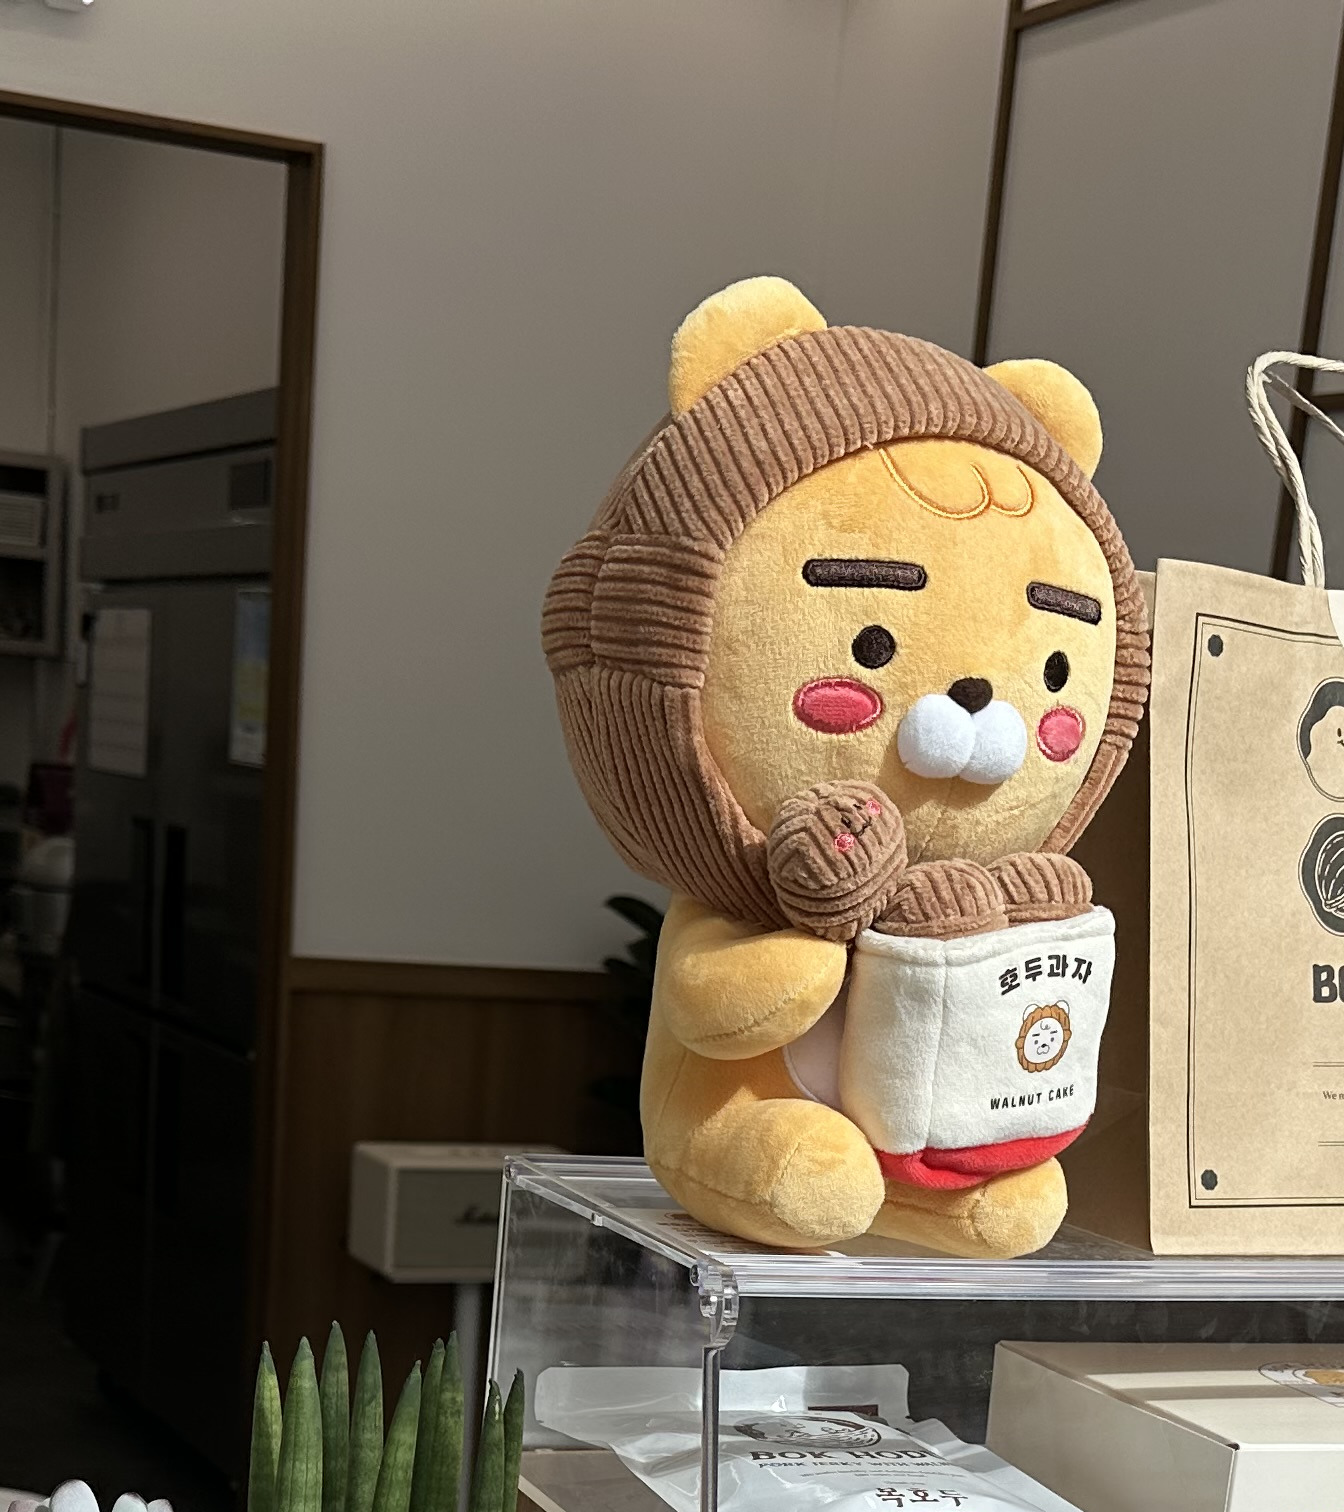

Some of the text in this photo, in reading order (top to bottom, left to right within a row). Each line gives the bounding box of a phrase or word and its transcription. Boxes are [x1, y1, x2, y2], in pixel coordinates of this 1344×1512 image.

[998, 954, 1093, 996] 호두과자
[990, 1084, 1075, 1110] WALNUT CAKE
[1322, 1090, 1337, 1100] We
[750, 1450, 940, 1460] BOK HOD
